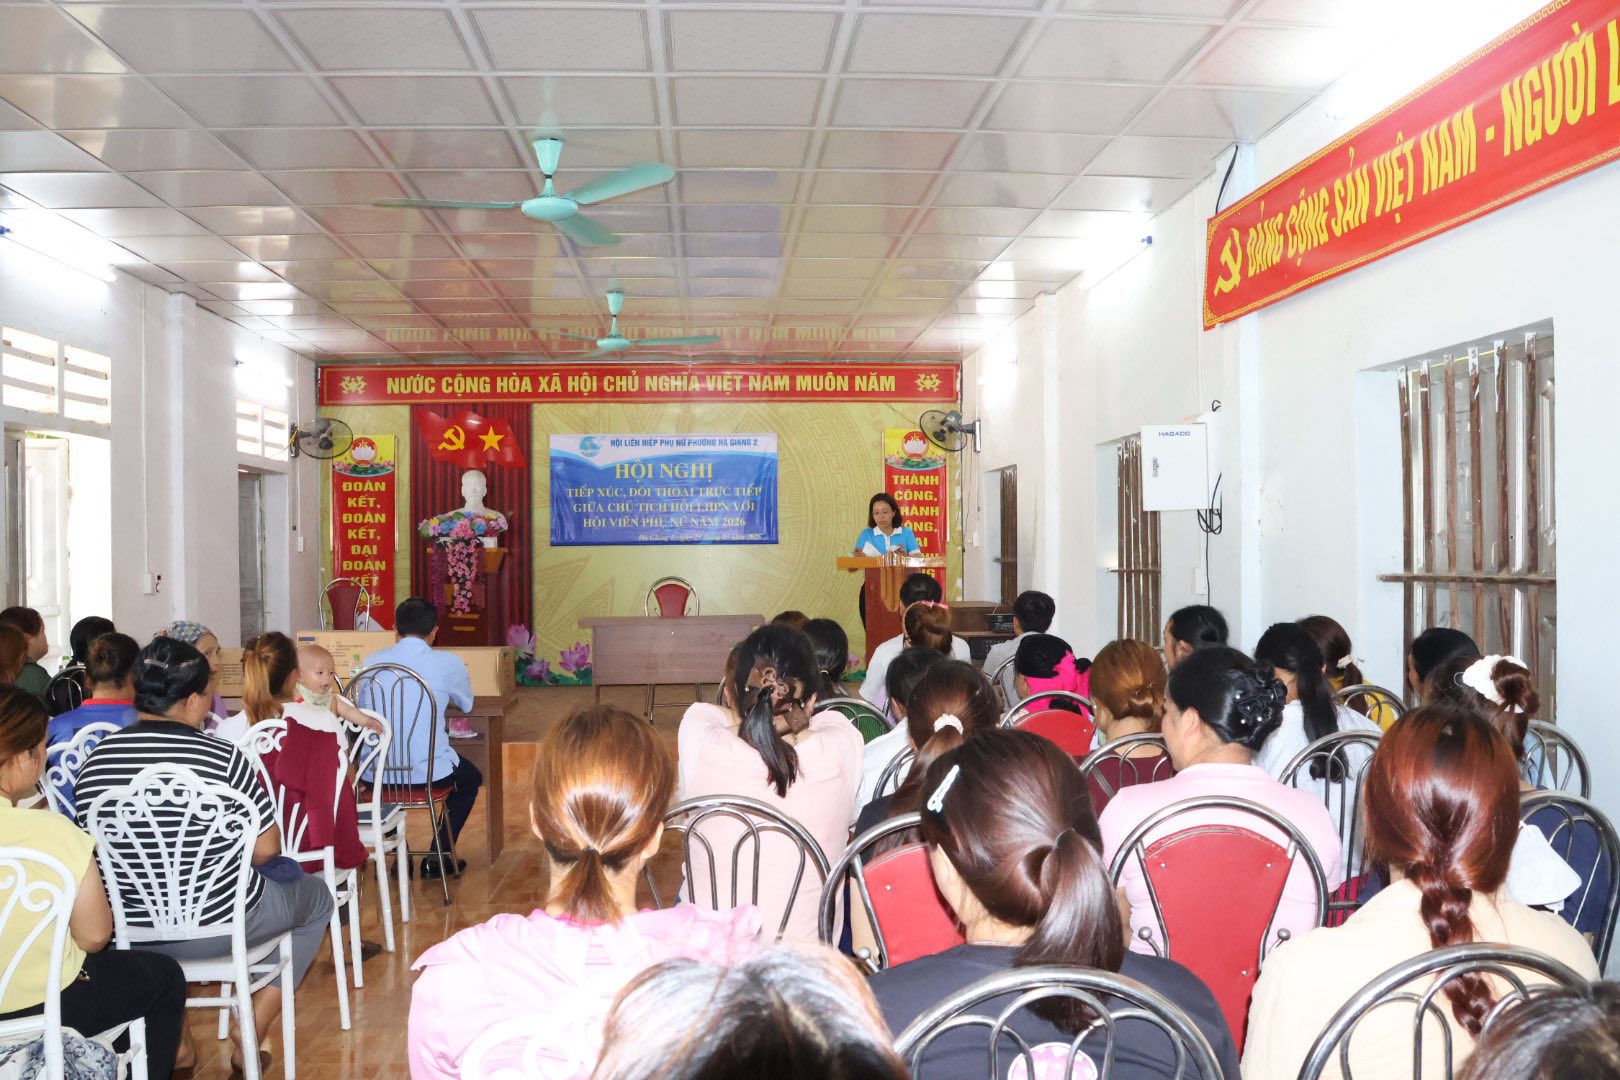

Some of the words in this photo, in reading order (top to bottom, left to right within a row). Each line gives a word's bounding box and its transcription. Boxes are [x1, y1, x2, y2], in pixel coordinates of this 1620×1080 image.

[1247, 200, 1284, 278] ĐẢNG
[1286, 188, 1330, 266] CỘNG
[1331, 146, 1370, 237] SẢN
[1373, 131, 1416, 224] VIỆT
[1421, 103, 1478, 195] NAM
[1500, 21, 1598, 157] NGƯỜI
[386, 373, 436, 394] NƯỚC
[441, 373, 491, 396] CỘNG
[497, 372, 532, 393] HÒA
[538, 372, 562, 393] XÃ
[568, 371, 597, 396] HỘI
[603, 370, 639, 392] CHỦ
[645, 371, 700, 392] NGHĨA
[706, 371, 743, 396] VIỆT
[748, 375, 790, 392] NAM
[796, 371, 850, 392] MUÔN
[855, 371, 896, 392] NĂM
[730, 438, 751, 446] GIANG
[615, 459, 653, 483] HỘI
[660, 462, 713, 482] NGHỊ
[342, 480, 386, 492] ĐOÀN
[893, 474, 939, 486] THÀNH
[567, 484, 594, 498] TIẾP
[735, 482, 762, 496] TIẾP
[894, 490, 938, 502] CÔNG,
[347, 494, 381, 509] KẾT,
[733, 500, 756, 511] VỚI
[900, 505, 940, 516] HÀNH
[342, 511, 386, 524] ĐOÀN
[583, 516, 606, 529] HỘI
[609, 515, 639, 527] VIÊN
[722, 517, 746, 527] 2026
[347, 525, 381, 540] KẾT,
[902, 520, 938, 532] ÔNG,
[351, 544, 377, 557] ĐẠI
[342, 559, 386, 571] ĐOÀN
